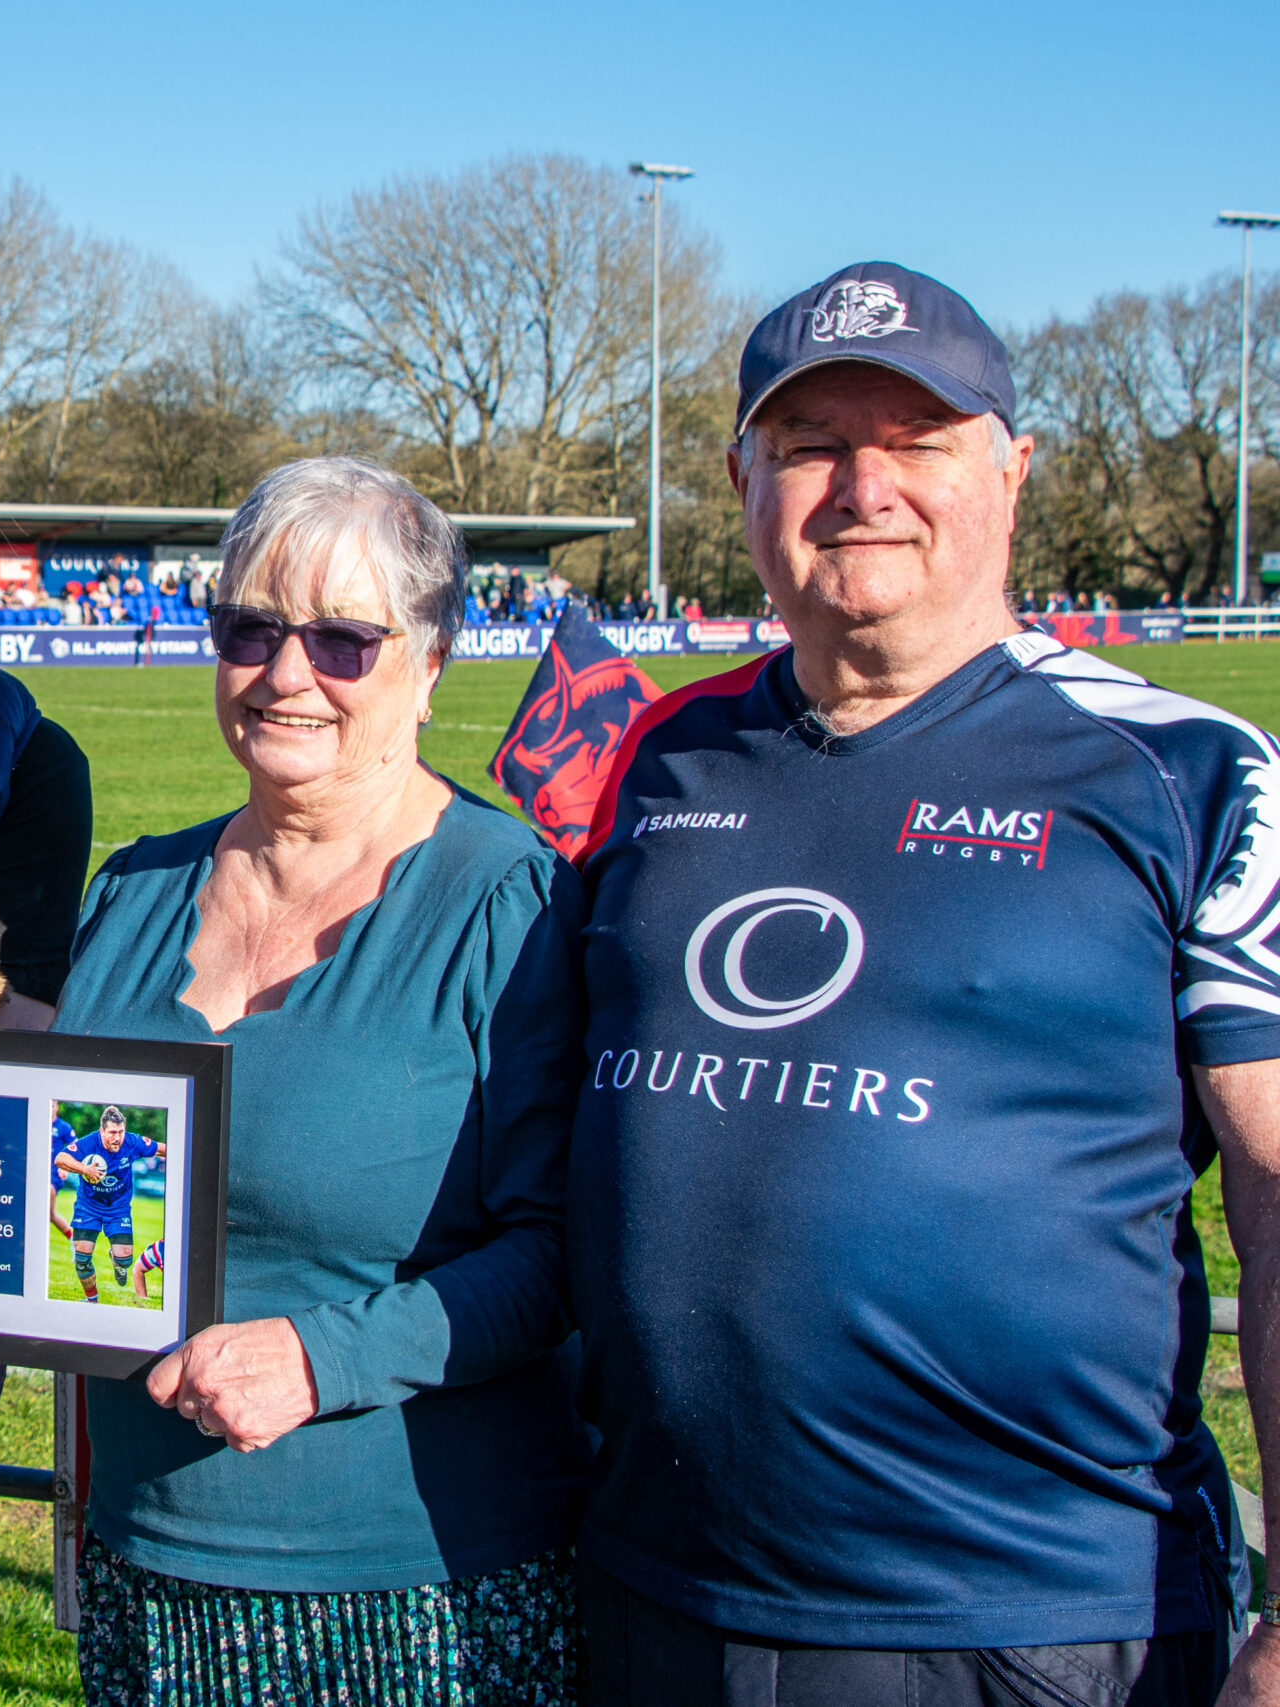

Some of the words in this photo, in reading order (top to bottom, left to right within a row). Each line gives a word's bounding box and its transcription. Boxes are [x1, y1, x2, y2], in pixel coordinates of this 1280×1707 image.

[647, 813, 747, 832] SAMURAI
[912, 802, 1042, 842] RAMS
[905, 841, 1033, 867] RUGBY
[594, 1048, 936, 1123] COURTIERS
